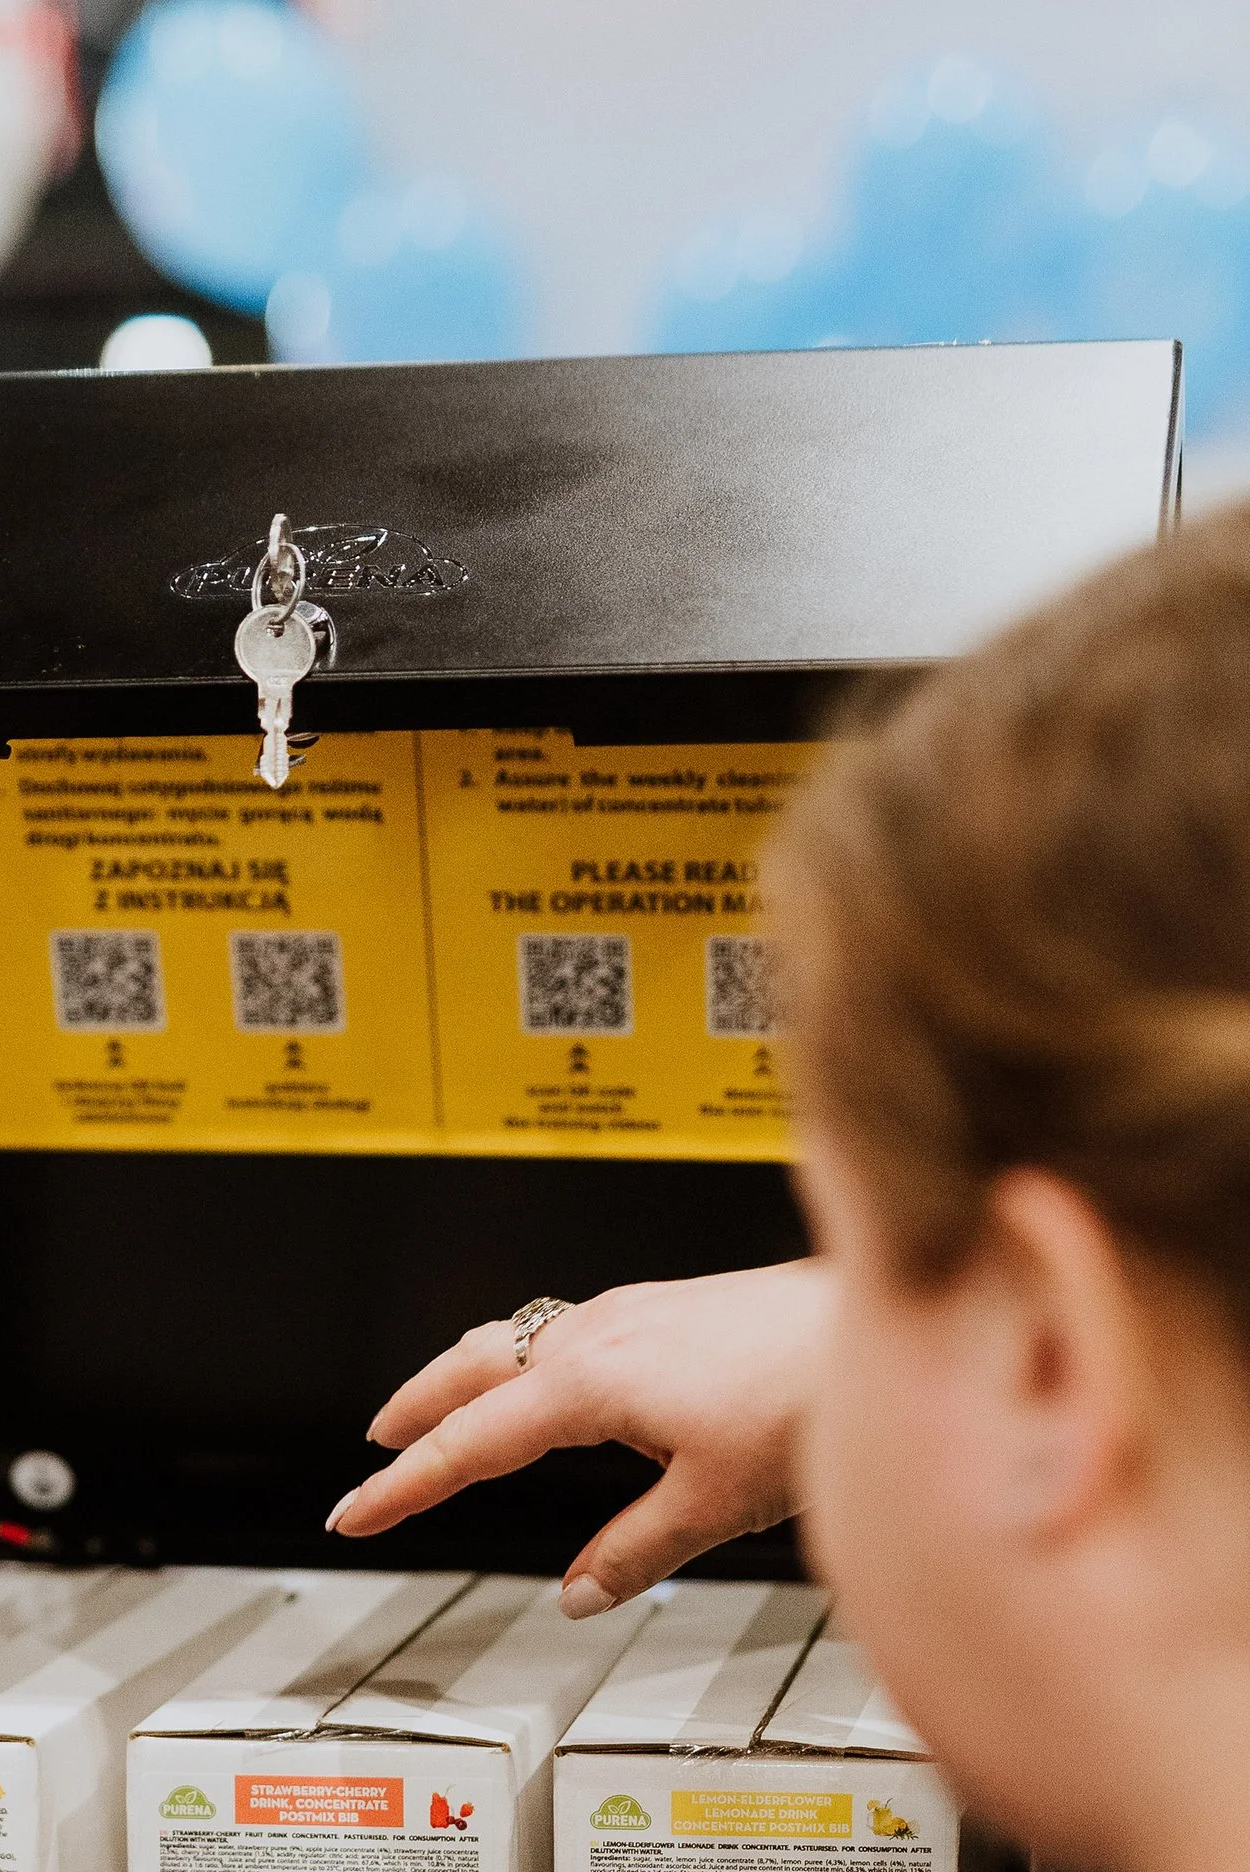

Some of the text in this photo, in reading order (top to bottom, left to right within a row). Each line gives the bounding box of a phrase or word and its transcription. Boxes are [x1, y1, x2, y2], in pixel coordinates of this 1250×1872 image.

[189, 564, 443, 591] PUENA
[92, 859, 290, 884] ZAPOZNAJ SIĘ
[572, 860, 674, 881] PLEASE
[95, 889, 290, 915] Z INSTRUKCJĄ
[490, 890, 540, 912] THE
[551, 891, 714, 914] OPERATION
[251, 1785, 387, 1797] STRAWBERRY-CHERRY
[251, 1798, 388, 1810] DRINK, CONCENTRATE
[692, 1794, 831, 1805] LEMON-ELDERFLOWER
[163, 1804, 212, 1816] PURENA
[705, 1808, 818, 1819] LEMONADE DRINK
[279, 1811, 359, 1823] POSTMIX BIB
[595, 1814, 646, 1826] PURENA
[674, 1821, 849, 1833] CONCENTRATE POSTMIX BIB
